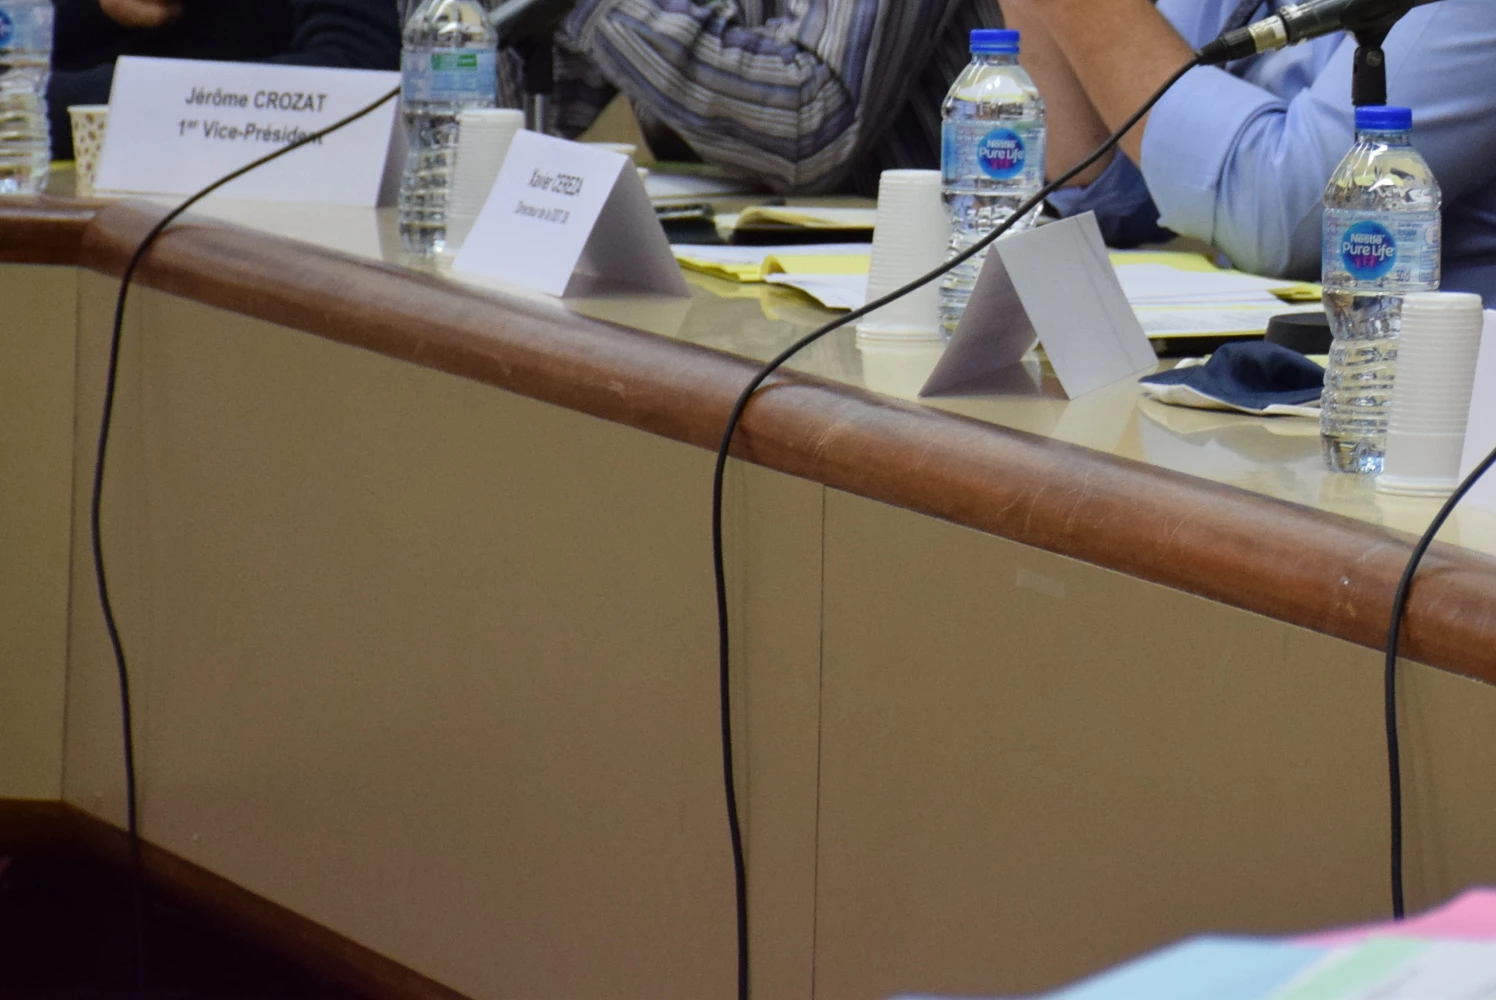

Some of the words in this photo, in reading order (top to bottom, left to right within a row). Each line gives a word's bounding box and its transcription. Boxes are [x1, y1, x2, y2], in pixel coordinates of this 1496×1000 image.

[185, 85, 249, 109] Jérôme
[253, 90, 327, 113] CROZAT
[978, 147, 1006, 159] Pure
[1007, 148, 1025, 163] Life
[1343, 242, 1371, 256] Pure
[1372, 244, 1395, 262] Life
